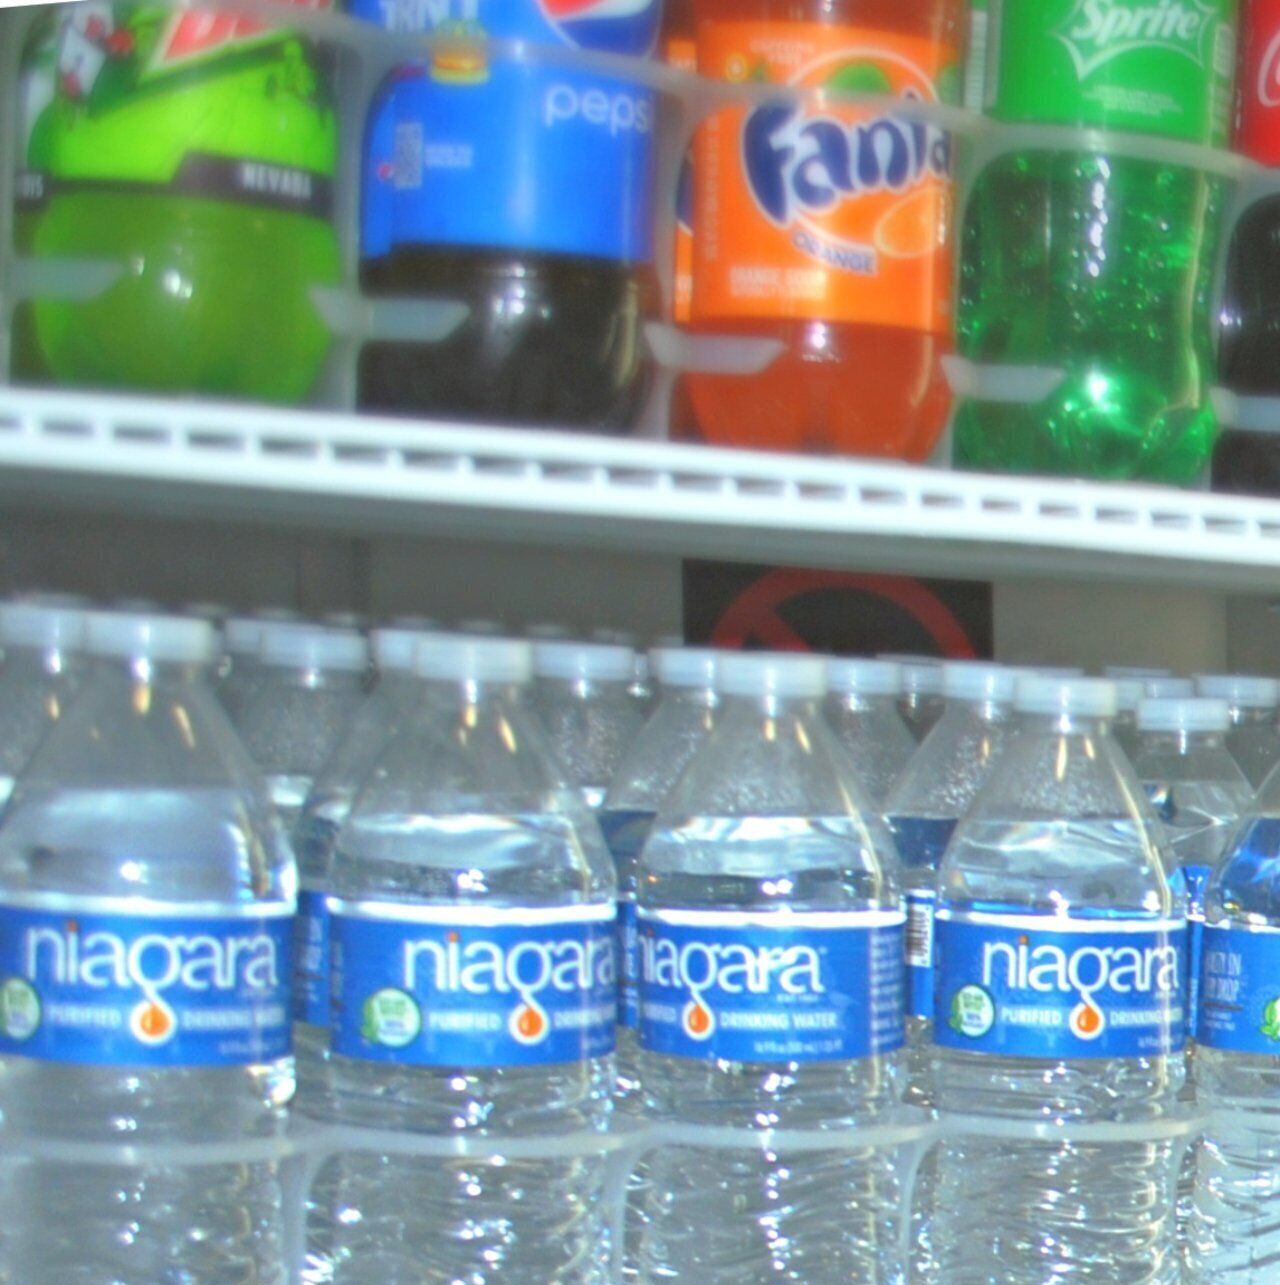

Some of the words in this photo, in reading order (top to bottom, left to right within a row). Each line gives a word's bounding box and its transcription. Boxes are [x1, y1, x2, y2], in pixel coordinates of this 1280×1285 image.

[1070, 0, 1200, 46] Sprite
[26, 920, 279, 1004] niagara
[403, 931, 616, 1008] niagara
[982, 934, 1179, 1008] niagara
[720, 1011, 789, 1029] DRINKING
[793, 1012, 837, 1028] WATER
[1001, 1006, 1063, 1026] PURIFIED
